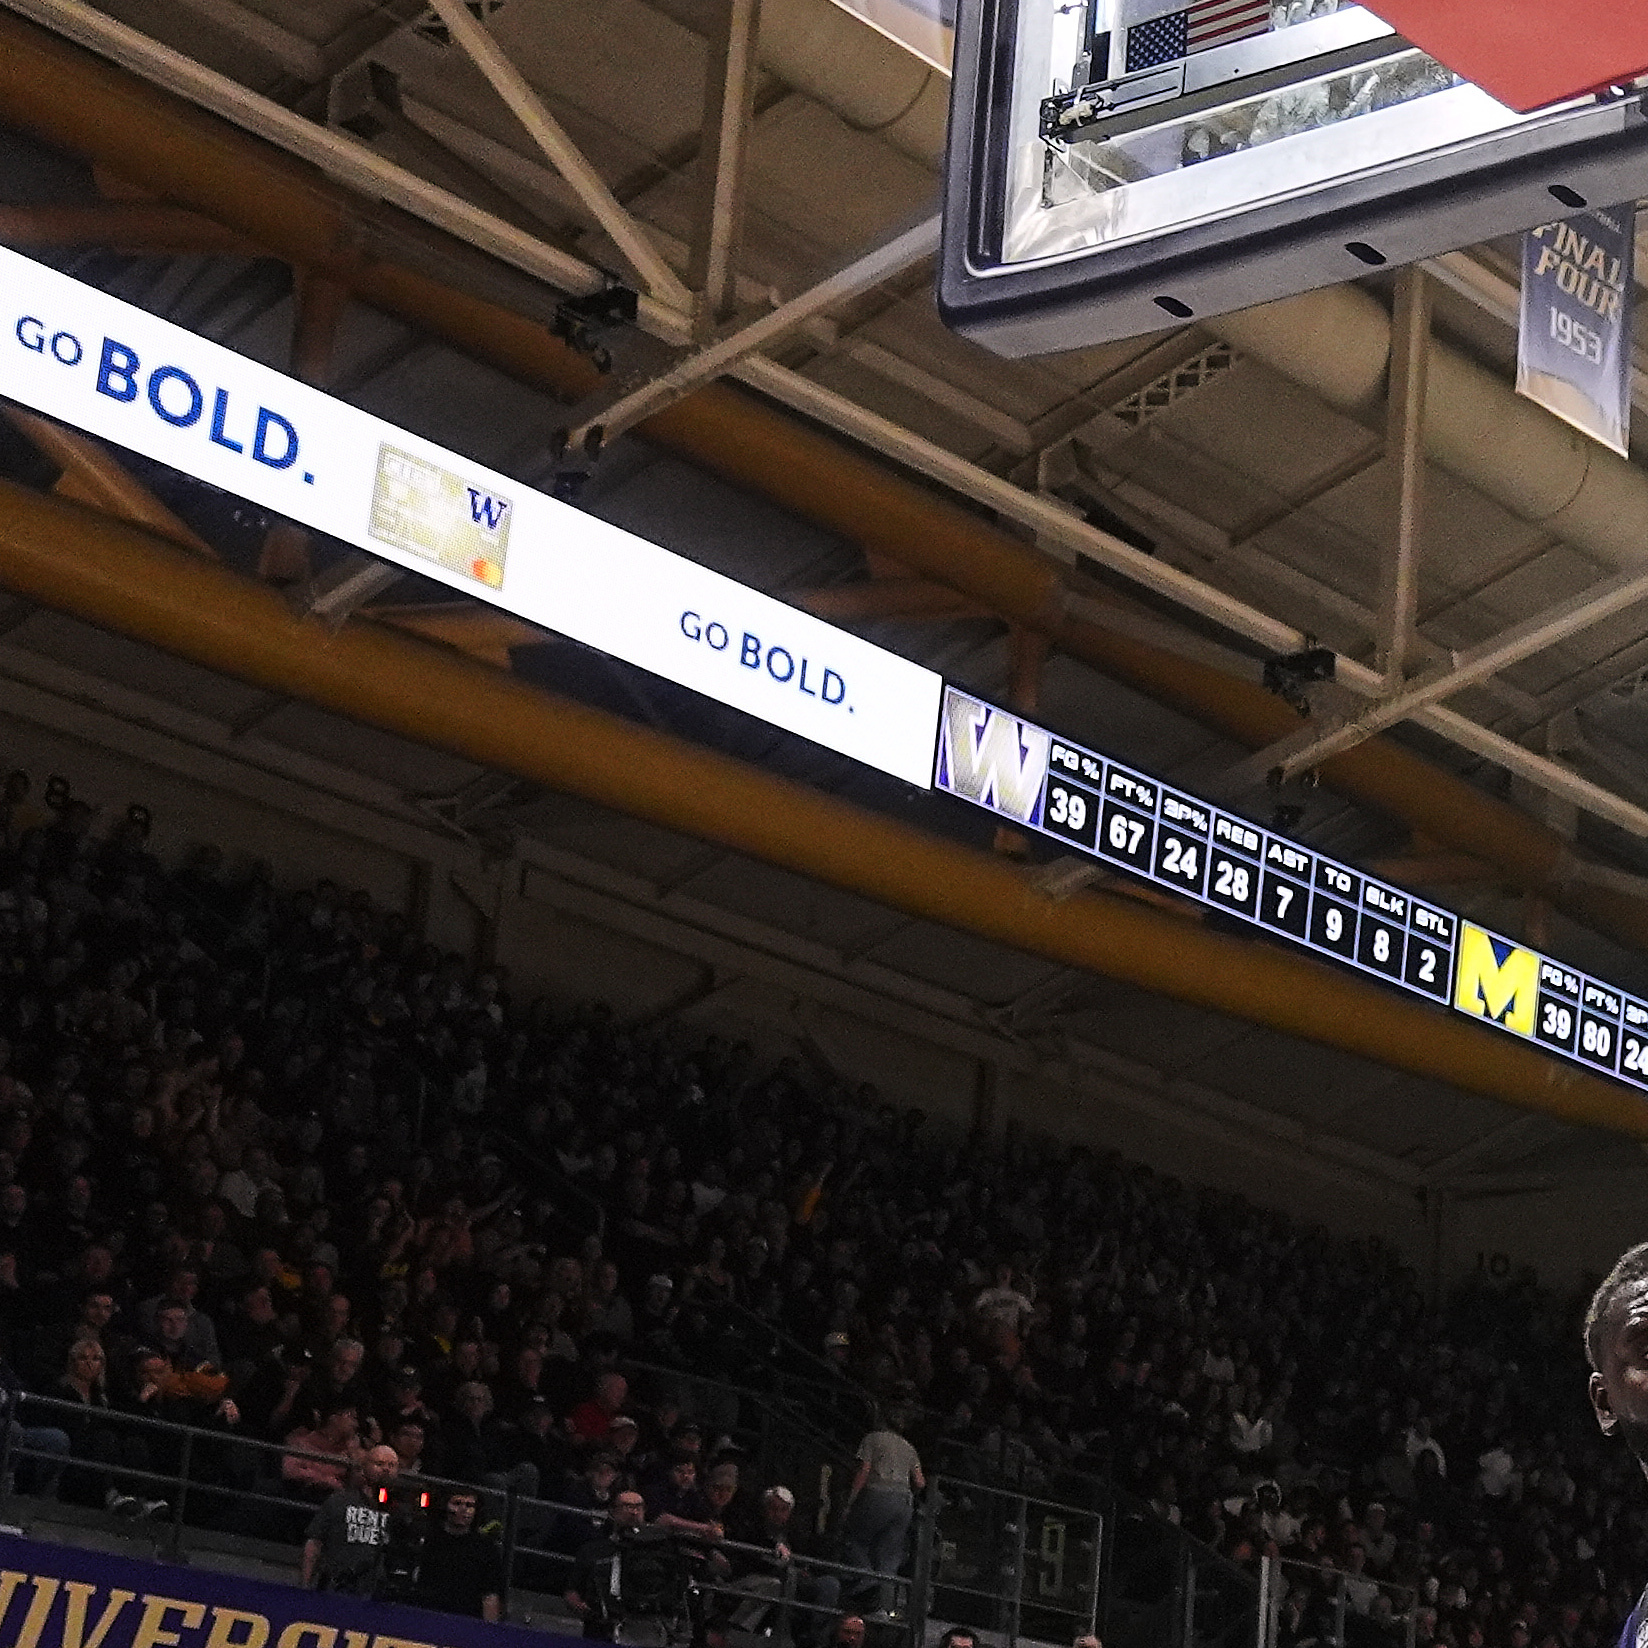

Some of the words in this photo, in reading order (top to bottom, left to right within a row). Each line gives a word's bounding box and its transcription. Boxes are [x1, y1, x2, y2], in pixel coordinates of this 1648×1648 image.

[1550, 306, 1602, 366] 1953
[16, 316, 82, 366] GO
[96, 337, 316, 484] BOLD.
[679, 610, 729, 652] GO
[739, 634, 856, 714] BOLD.
[1049, 788, 1086, 831] 39
[1108, 814, 1145, 855] 67
[1163, 838, 1198, 881] 24
[1215, 861, 1249, 902] 28
[1275, 886, 1294, 919] 7
[1325, 909, 1343, 942] 9
[1372, 929, 1390, 962] 8
[1418, 949, 1437, 983] 2
[1216, 818, 1258, 852] REB
[1267, 837, 1308, 873] AST
[1324, 865, 1352, 893] TO
[1365, 885, 1405, 916] BLK
[1415, 907, 1449, 937] STL
[1541, 1003, 1571, 1040] 39
[1583, 1020, 1611, 1058] 80
